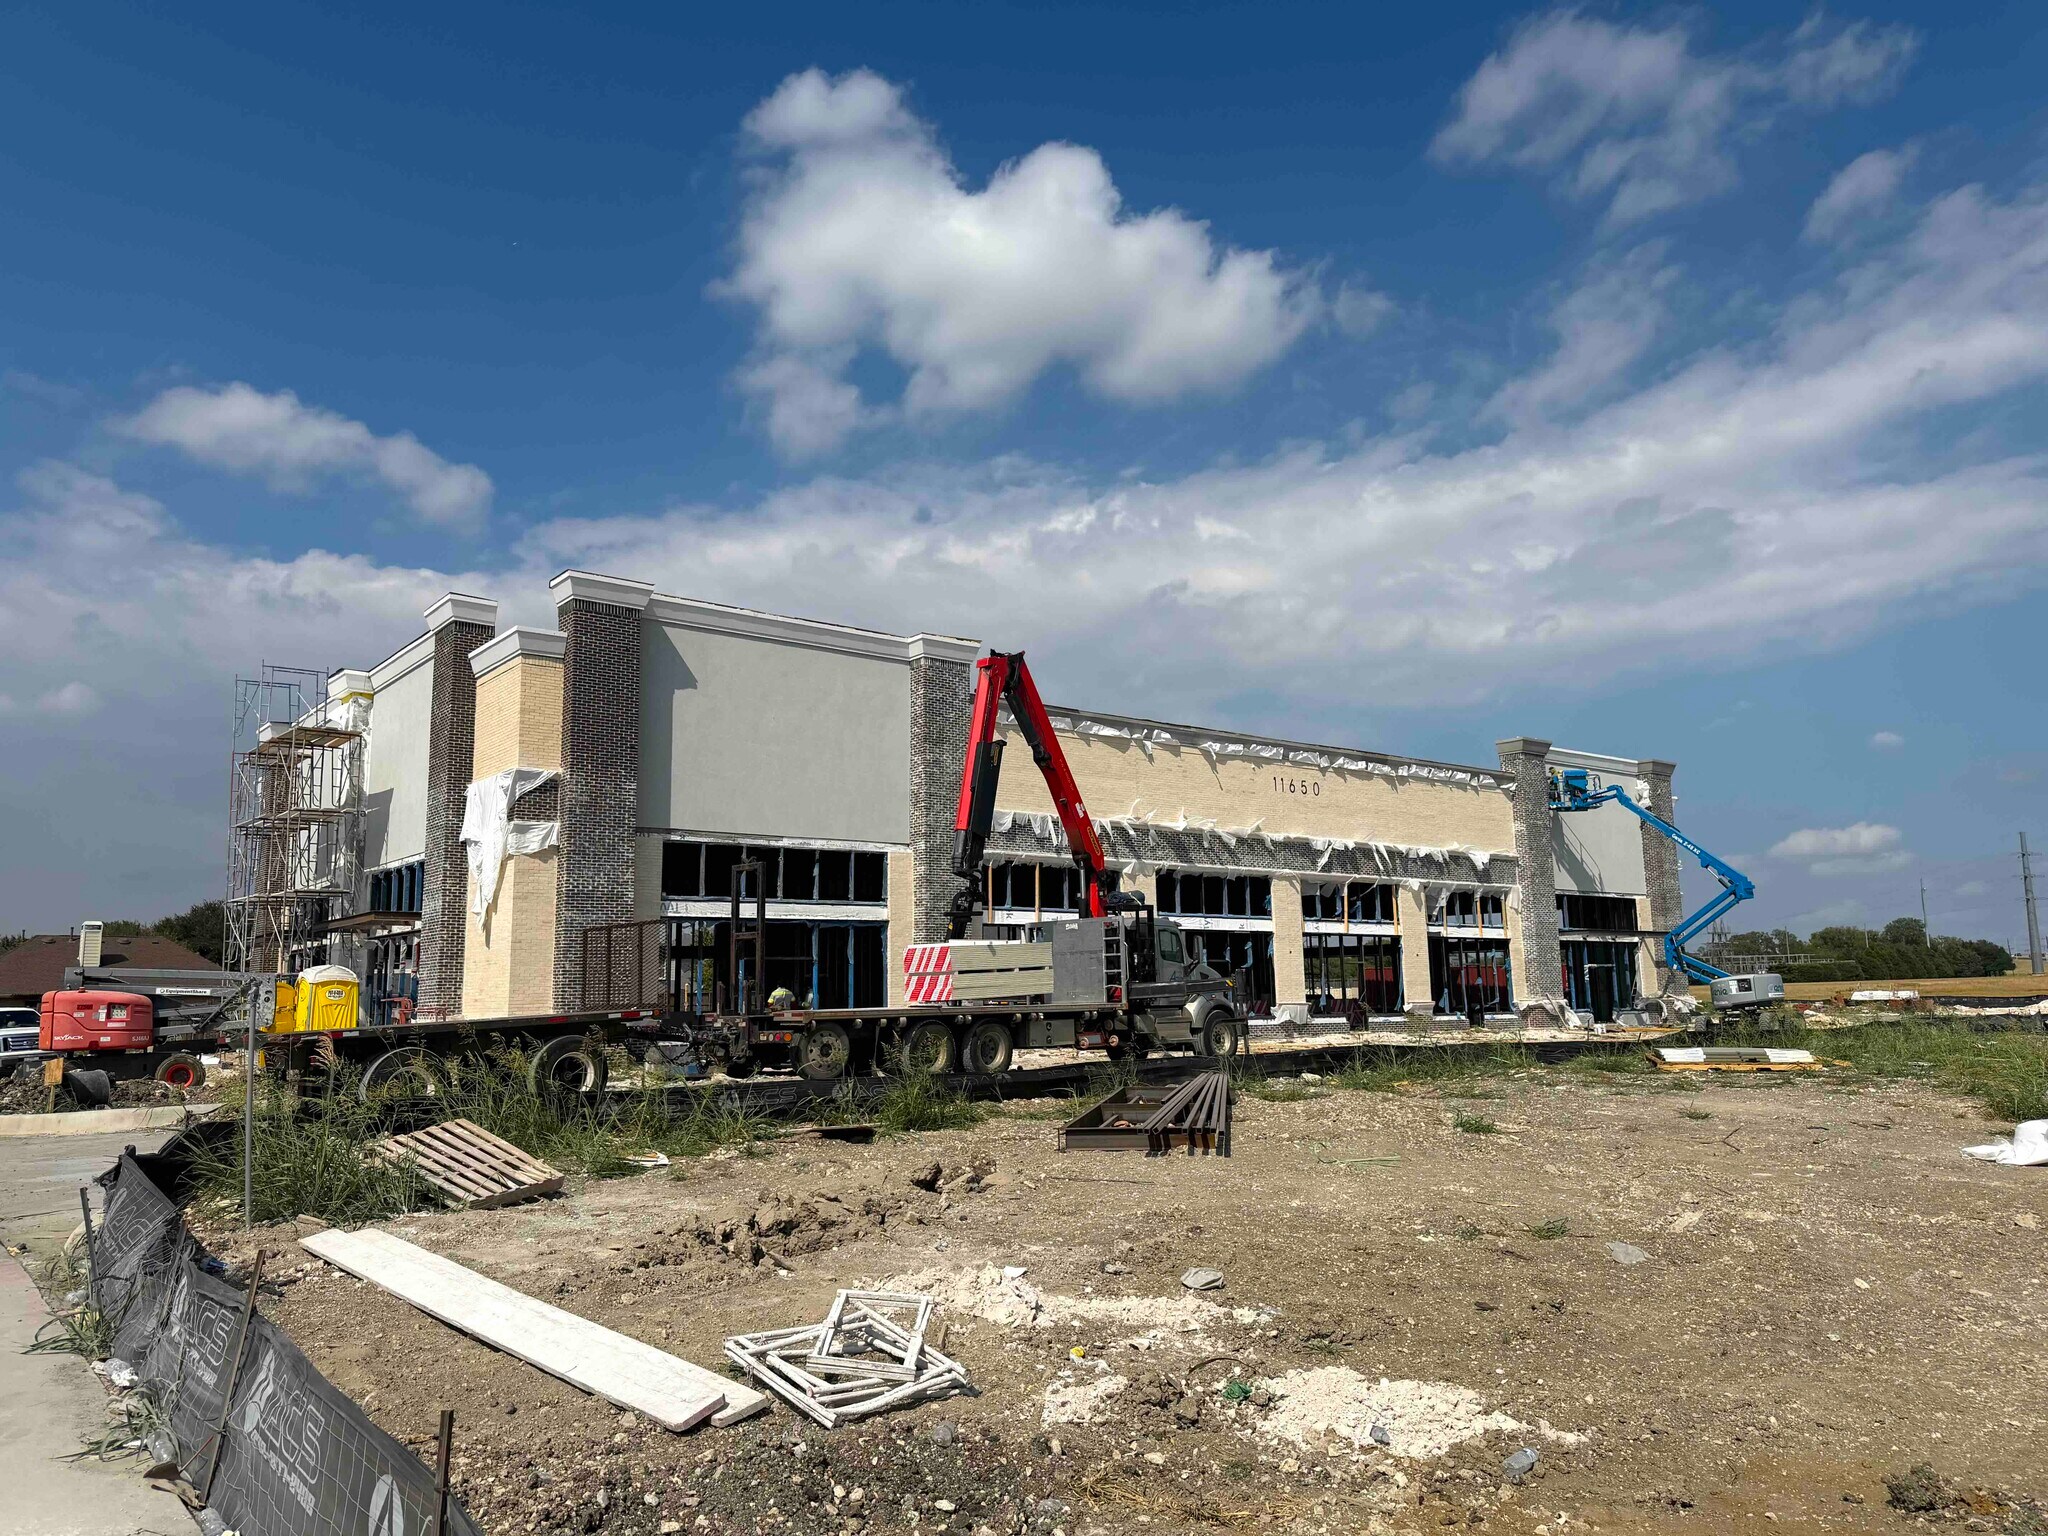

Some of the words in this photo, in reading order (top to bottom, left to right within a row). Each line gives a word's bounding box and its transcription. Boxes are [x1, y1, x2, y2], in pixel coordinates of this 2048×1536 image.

[1273, 776, 1320, 797] 11650
[746, 1086, 797, 1106] ACS
[259, 1373, 325, 1485] ACS
